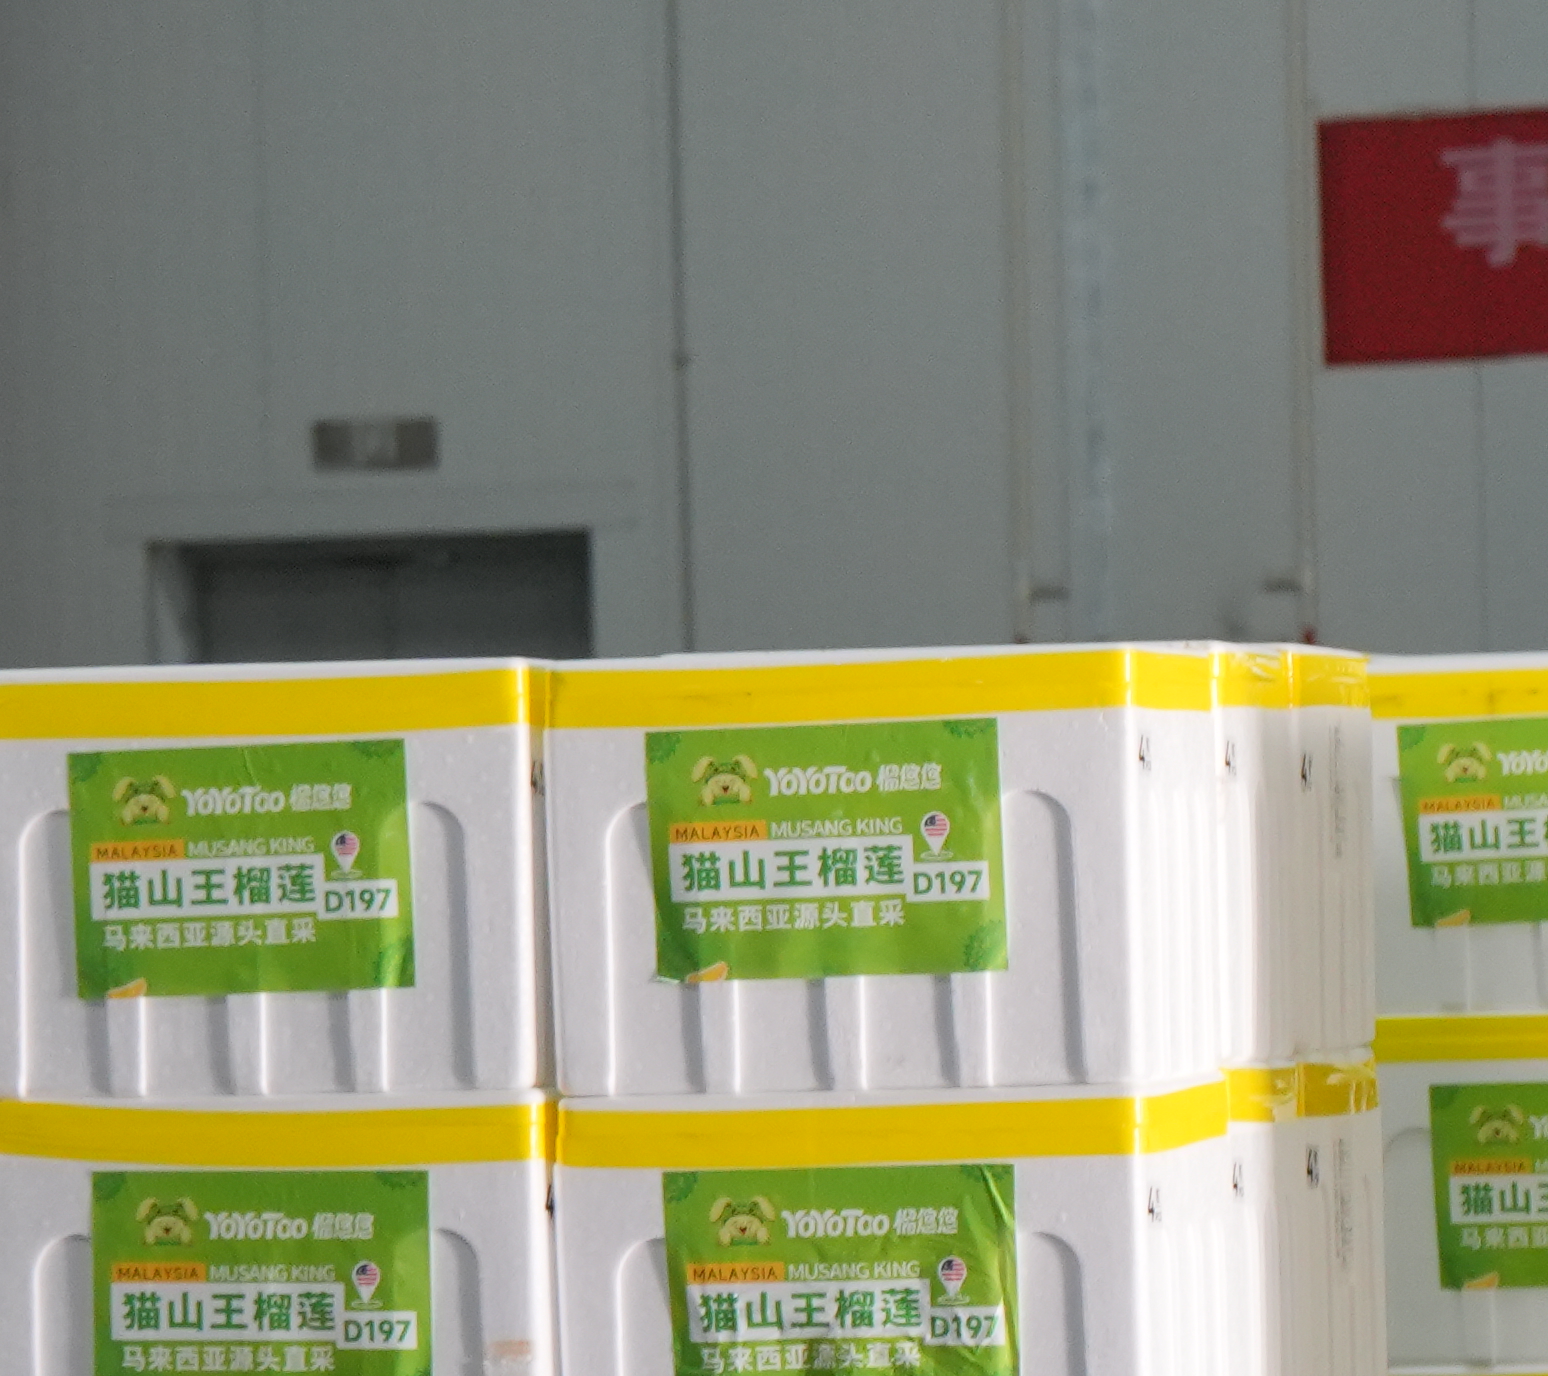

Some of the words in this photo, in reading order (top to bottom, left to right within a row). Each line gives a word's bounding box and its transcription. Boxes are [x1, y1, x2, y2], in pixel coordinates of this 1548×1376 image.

[672, 822, 759, 843] MALAYSIA
[770, 819, 854, 842] MUSANG
[856, 817, 905, 838] KING
[96, 844, 177, 860] MALAYSIA
[188, 839, 268, 861] MUSANG
[269, 837, 317, 857] KING
[681, 845, 904, 893] 猫山王榴莲
[913, 869, 982, 896] D197
[103, 863, 315, 910] 猫山王榴莲
[324, 888, 391, 914] D197
[679, 896, 904, 933] 马来西亚源头直采
[100, 913, 315, 951] 马来西亚源头直采
[117, 1266, 199, 1281] MALAYSIA
[210, 1263, 288, 1284] MUSANG
[288, 1264, 336, 1284] KING
[692, 1264, 777, 1284] MALAYSIA
[785, 1262, 871, 1284] MUSANG
[872, 1260, 921, 1281] KING
[123, 1291, 335, 1331] 猫山王榴莲
[696, 1288, 922, 1335] 猫山王榴莲
[343, 1318, 410, 1344] D197
[929, 1313, 996, 1341] D197
[122, 1345, 333, 1372] 马来西亚源头直采
[697, 1338, 921, 1373] 马来西亚源头直采
